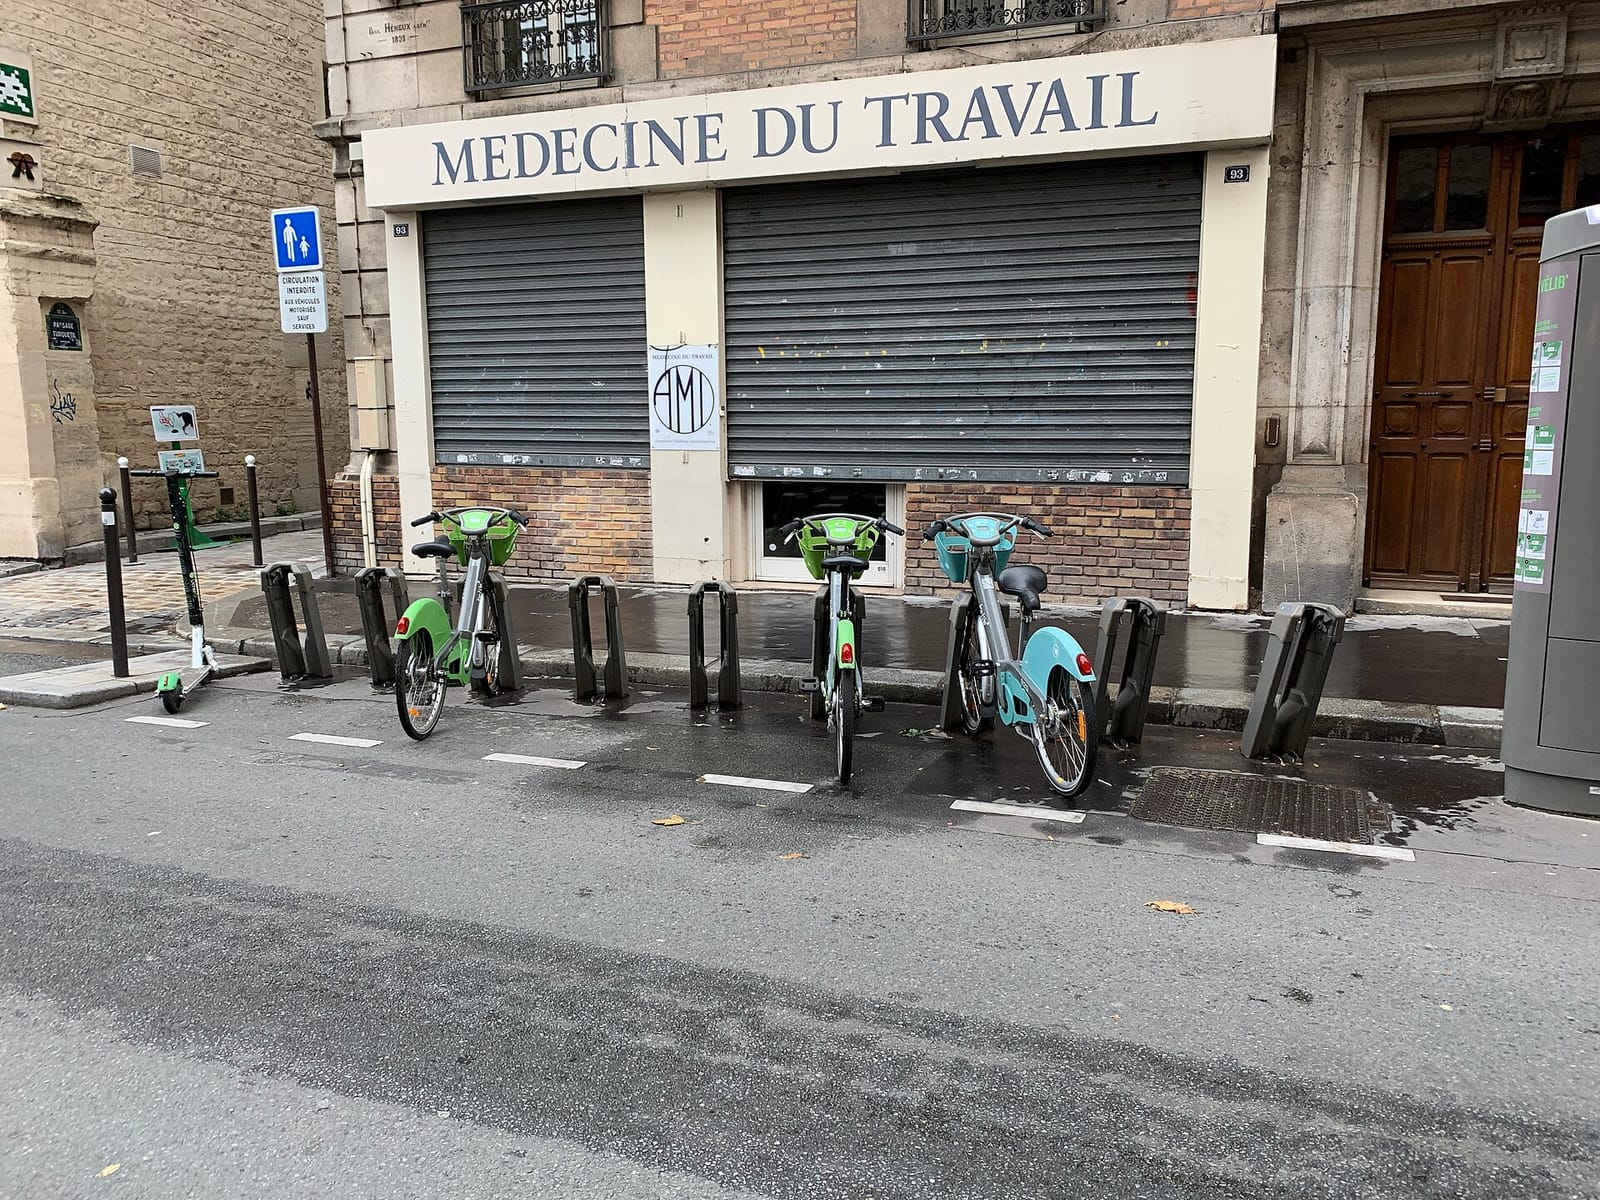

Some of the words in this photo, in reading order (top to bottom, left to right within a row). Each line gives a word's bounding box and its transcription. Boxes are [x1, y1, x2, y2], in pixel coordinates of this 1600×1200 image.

[432, 112, 728, 186] MEDECINE
[752, 100, 843, 158] DU
[864, 71, 1159, 148] TRAVAIL
[1230, 168, 1244, 180] 93
[395, 226, 406, 235] 93
[282, 276, 320, 284] CIRCULATION
[286, 286, 316, 294] INTERDITE
[52, 321, 75, 330] PASSAGE
